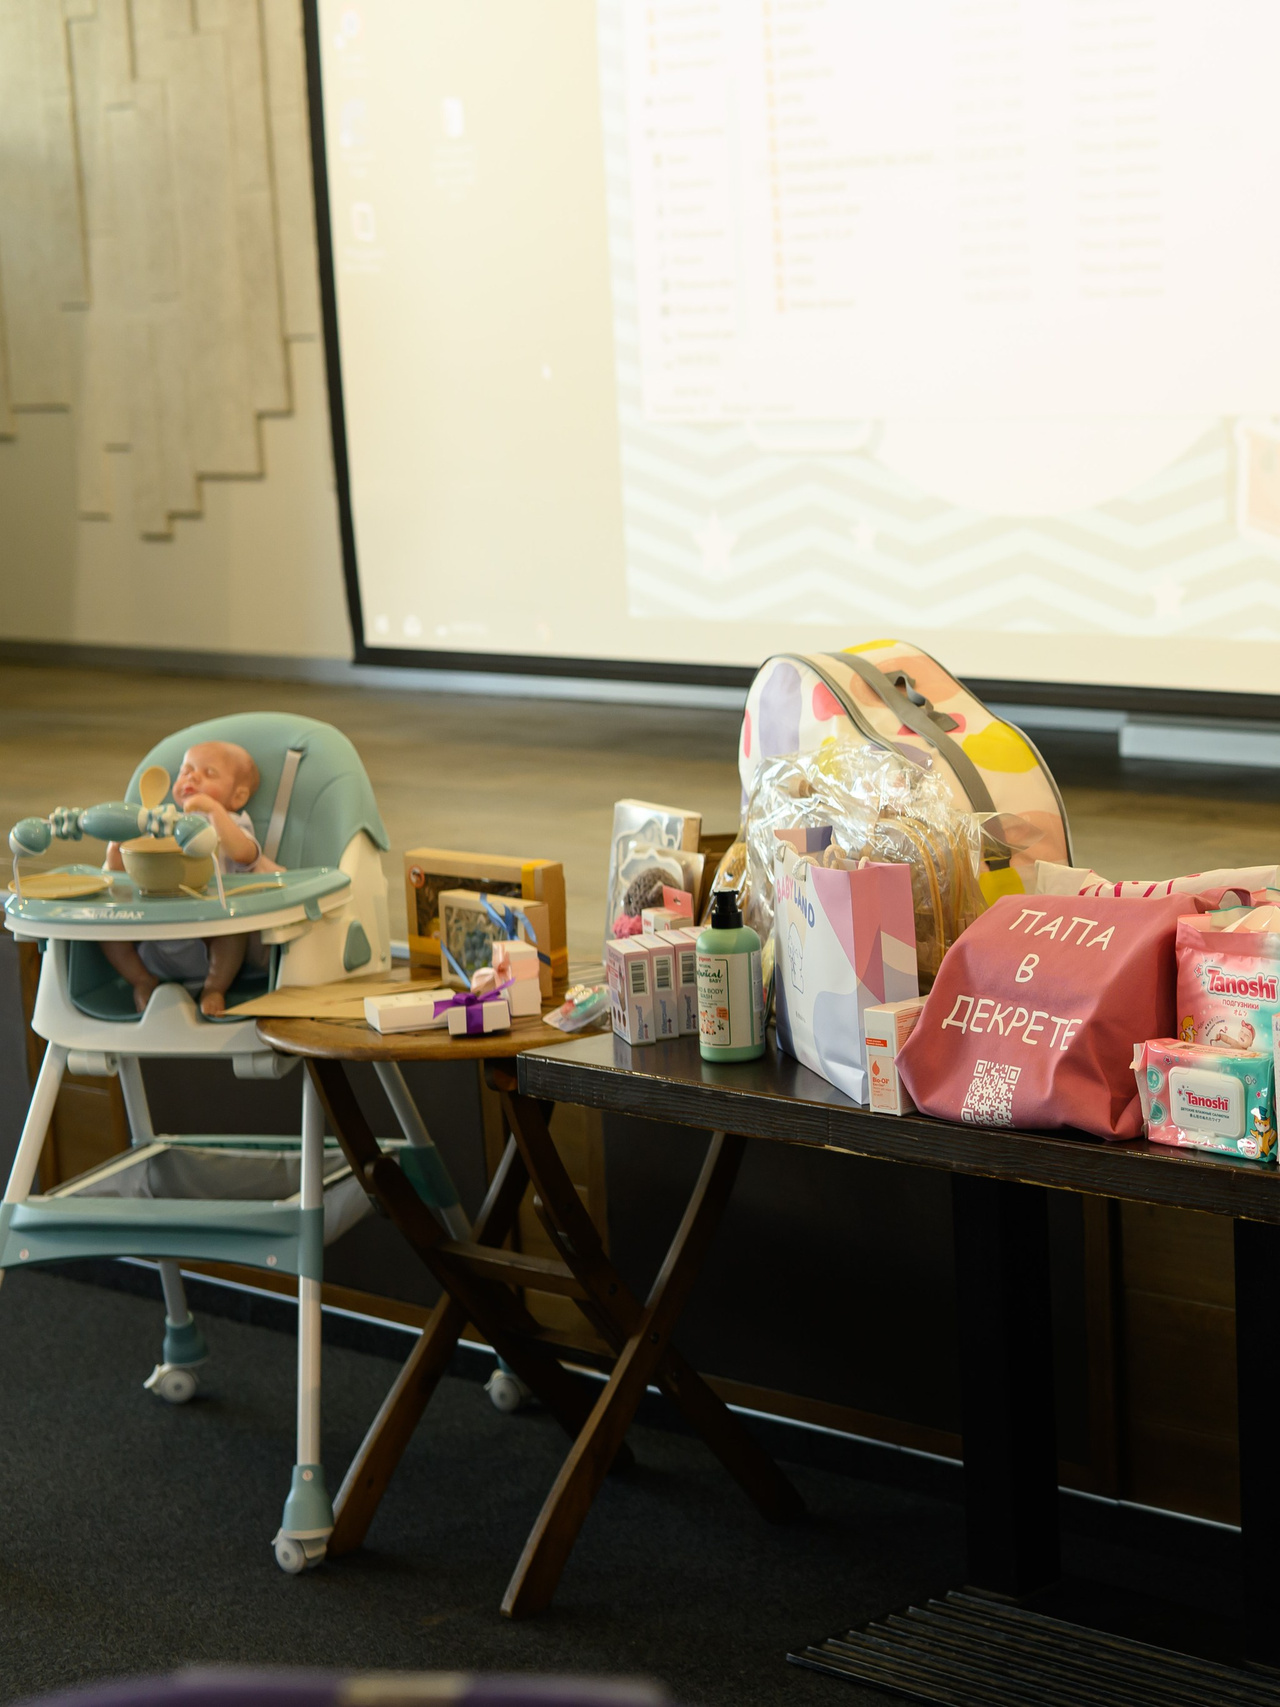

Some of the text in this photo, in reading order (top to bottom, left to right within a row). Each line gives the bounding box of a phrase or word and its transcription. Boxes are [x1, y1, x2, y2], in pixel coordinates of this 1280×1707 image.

[1008, 909, 1116, 951] ПАПА
[1015, 953, 1040, 983] В
[707, 987, 724, 995] BODY
[1222, 999, 1260, 1010] ПОДГУЗНИКИ
[941, 995, 1083, 1051] ДЕКРЕТЕ
